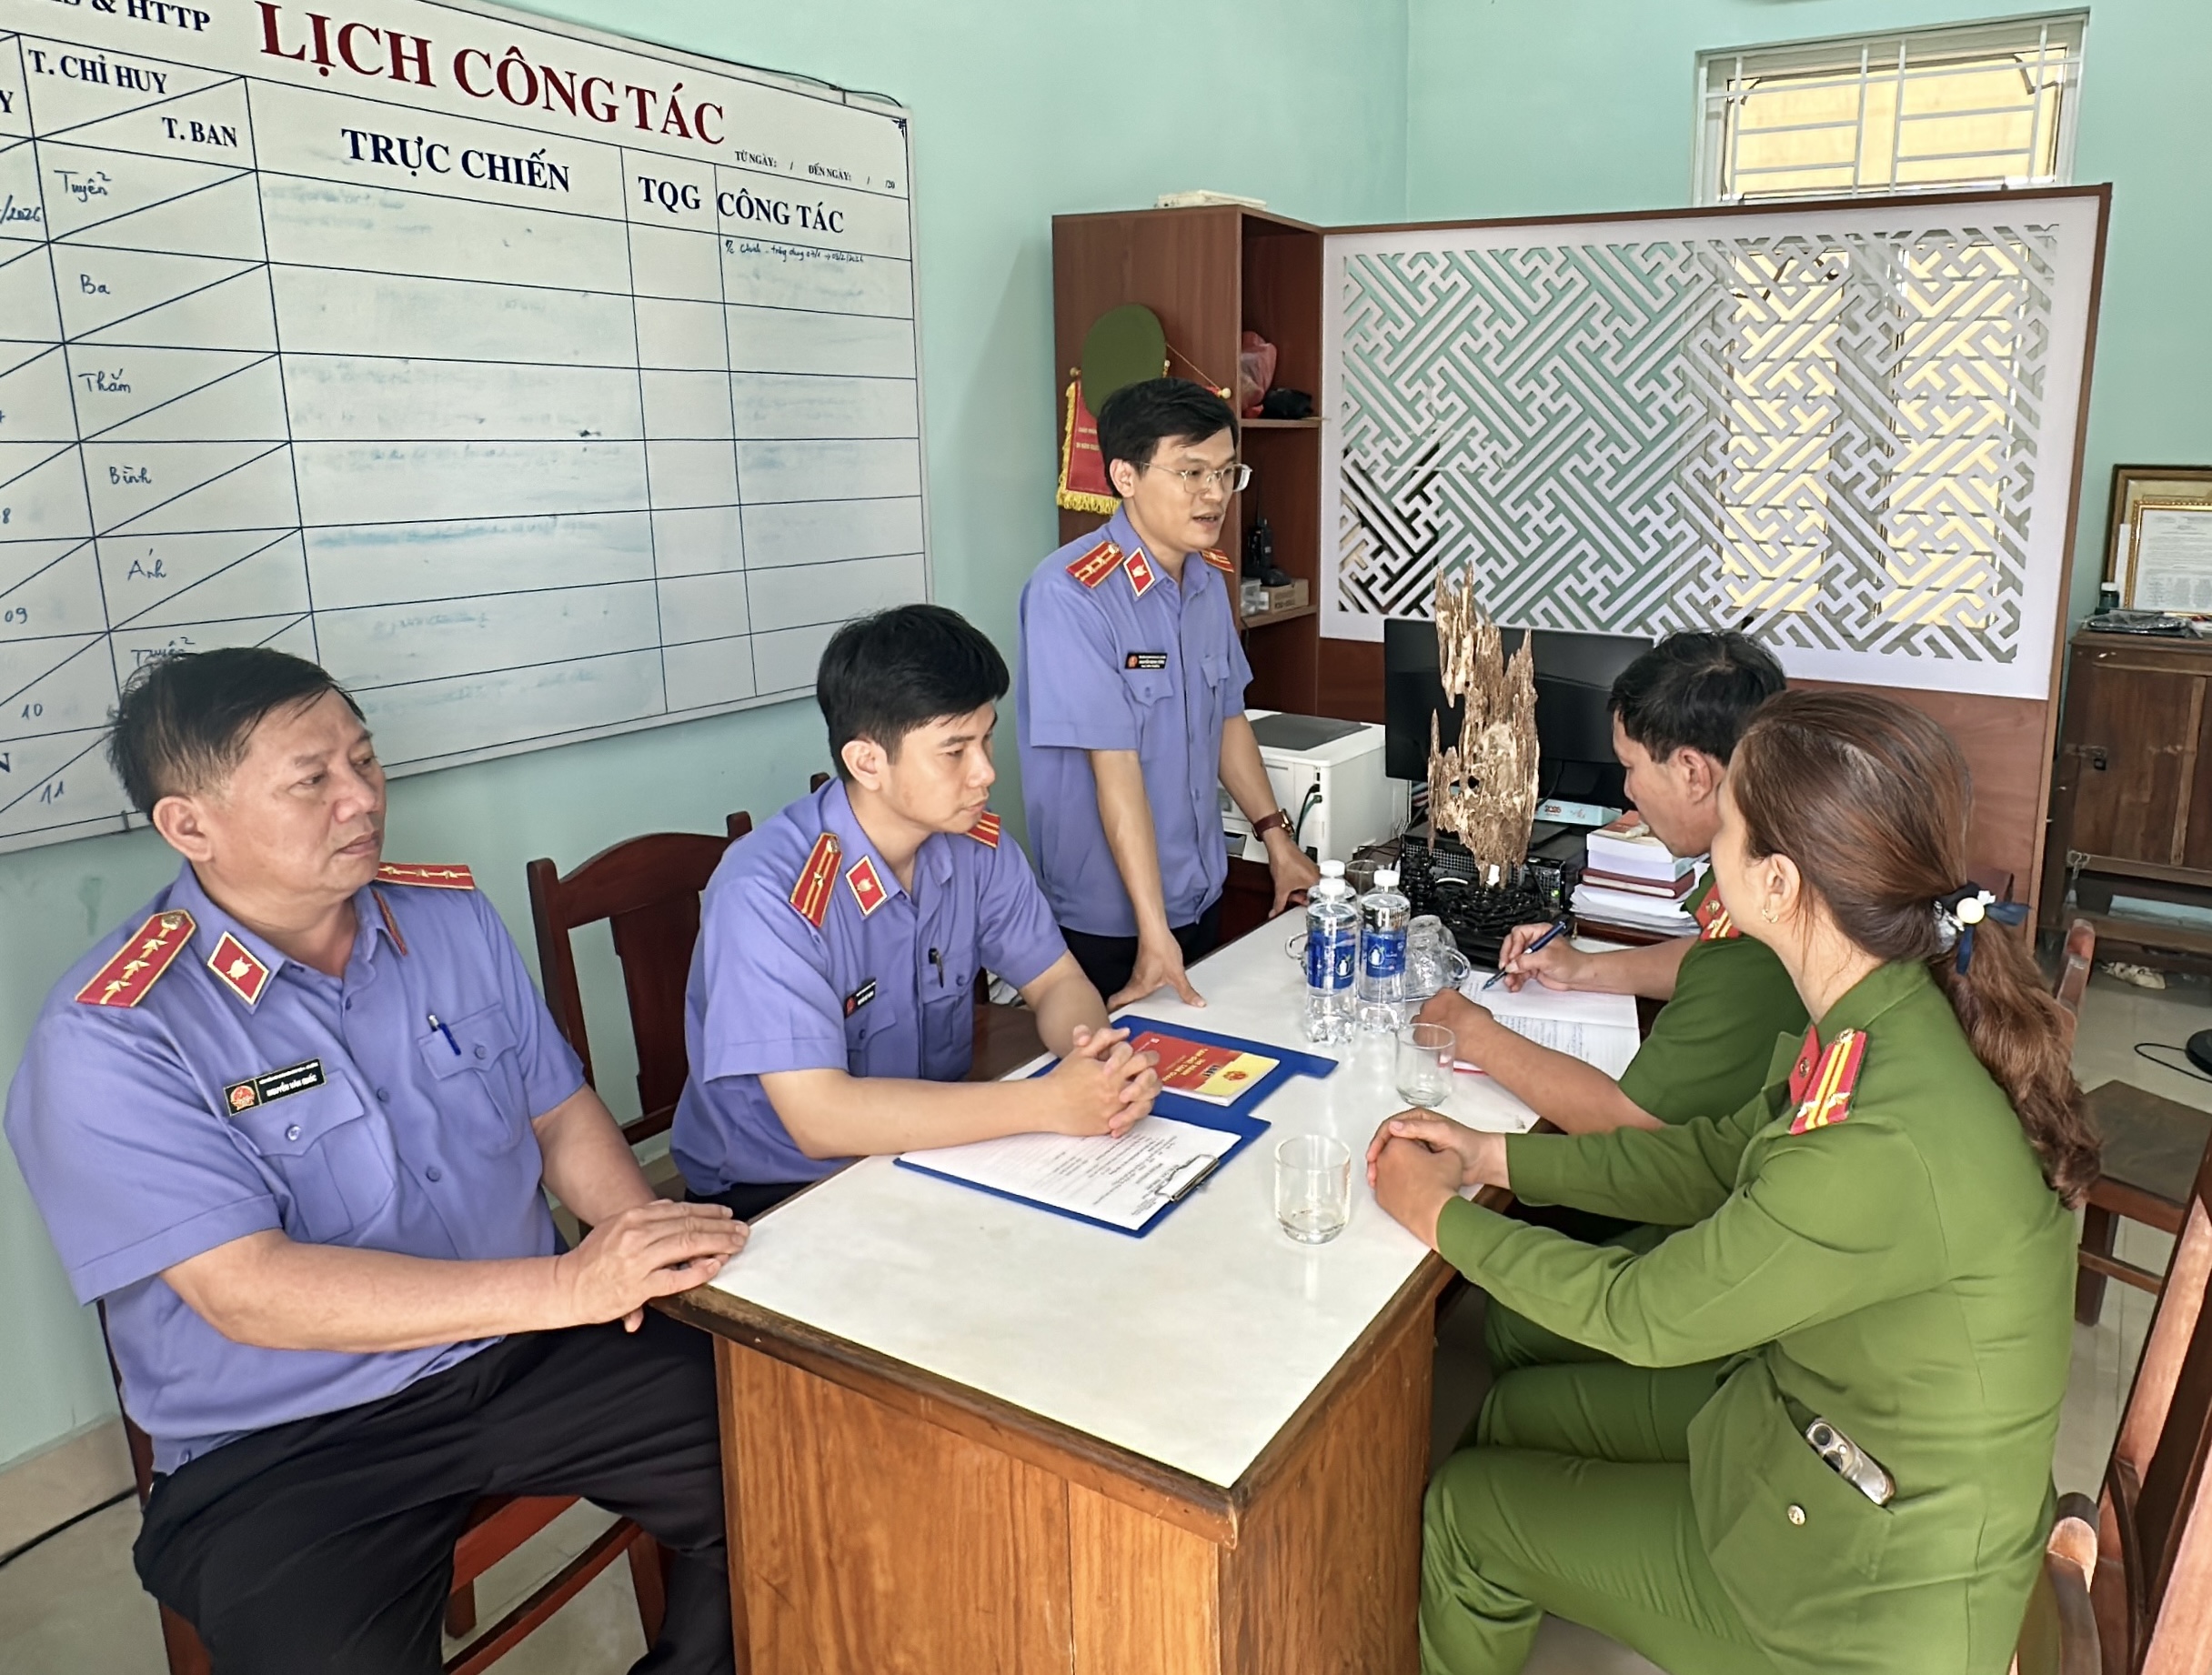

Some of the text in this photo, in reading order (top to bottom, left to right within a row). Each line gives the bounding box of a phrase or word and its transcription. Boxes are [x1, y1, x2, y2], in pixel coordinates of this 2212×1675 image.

[127, 0, 210, 31] HTTP
[28, 49, 166, 94] T. CHỈ HUY
[254, 1, 725, 145] LỊCH CÔNG TÁC
[161, 116, 237, 147] T. BAN
[341, 128, 570, 192] TRỰC CHIẾN
[0, 194, 41, 225] /2026
[638, 176, 701, 213] TQG
[718, 188, 844, 233] CÔNG TÁC
[80, 274, 110, 295] Ba
[2, 507, 11, 524] 8
[127, 548, 166, 581] Ánh
[5, 607, 27, 624] 09
[22, 703, 43, 720] 10
